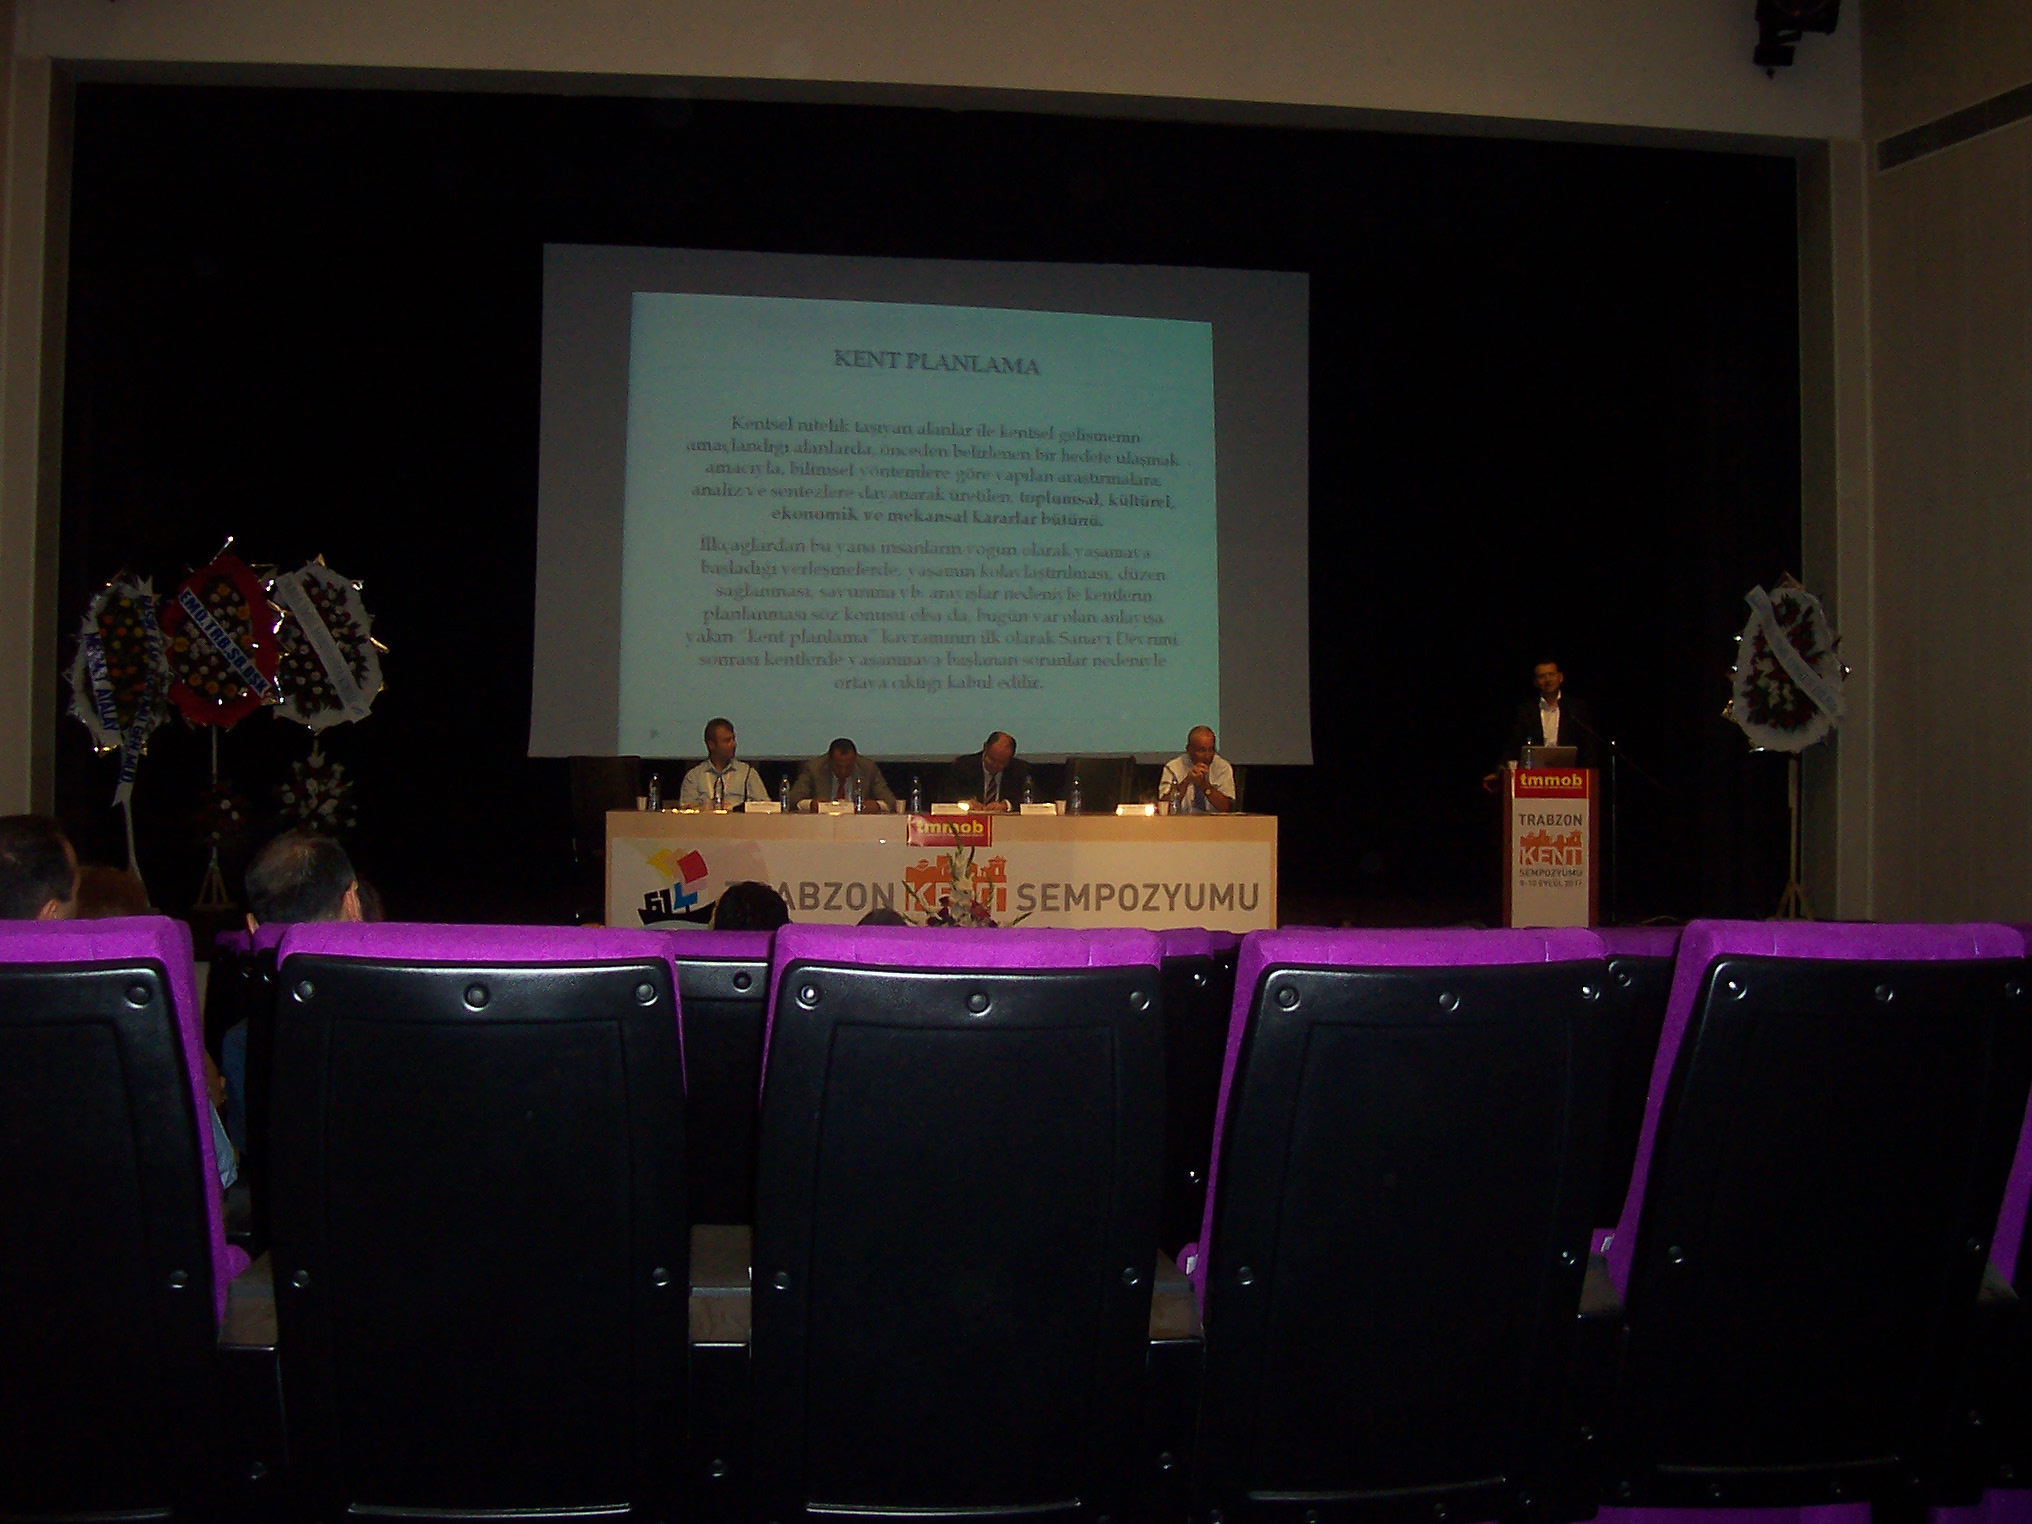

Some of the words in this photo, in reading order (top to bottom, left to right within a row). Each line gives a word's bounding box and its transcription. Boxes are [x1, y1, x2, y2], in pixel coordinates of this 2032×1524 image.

[834, 350, 901, 369] KENT
[906, 353, 1040, 376] PLANLAMA
[731, 416, 792, 431] Kentsel
[977, 424, 995, 437] ile
[1000, 425, 1053, 440] kentsel
[771, 507, 858, 520] ekonomik
[863, 510, 882, 521] ve
[973, 510, 1036, 525] kararlar
[811, 537, 832, 552] bu
[1519, 773, 1583, 786] tmmob
[915, 820, 984, 835] tmmob
[1519, 814, 1582, 826] TRABZON
[1520, 846, 1582, 865] KENT
[725, 881, 894, 911] ABZON
[1017, 882, 1259, 912] SEMPOZYUMU
